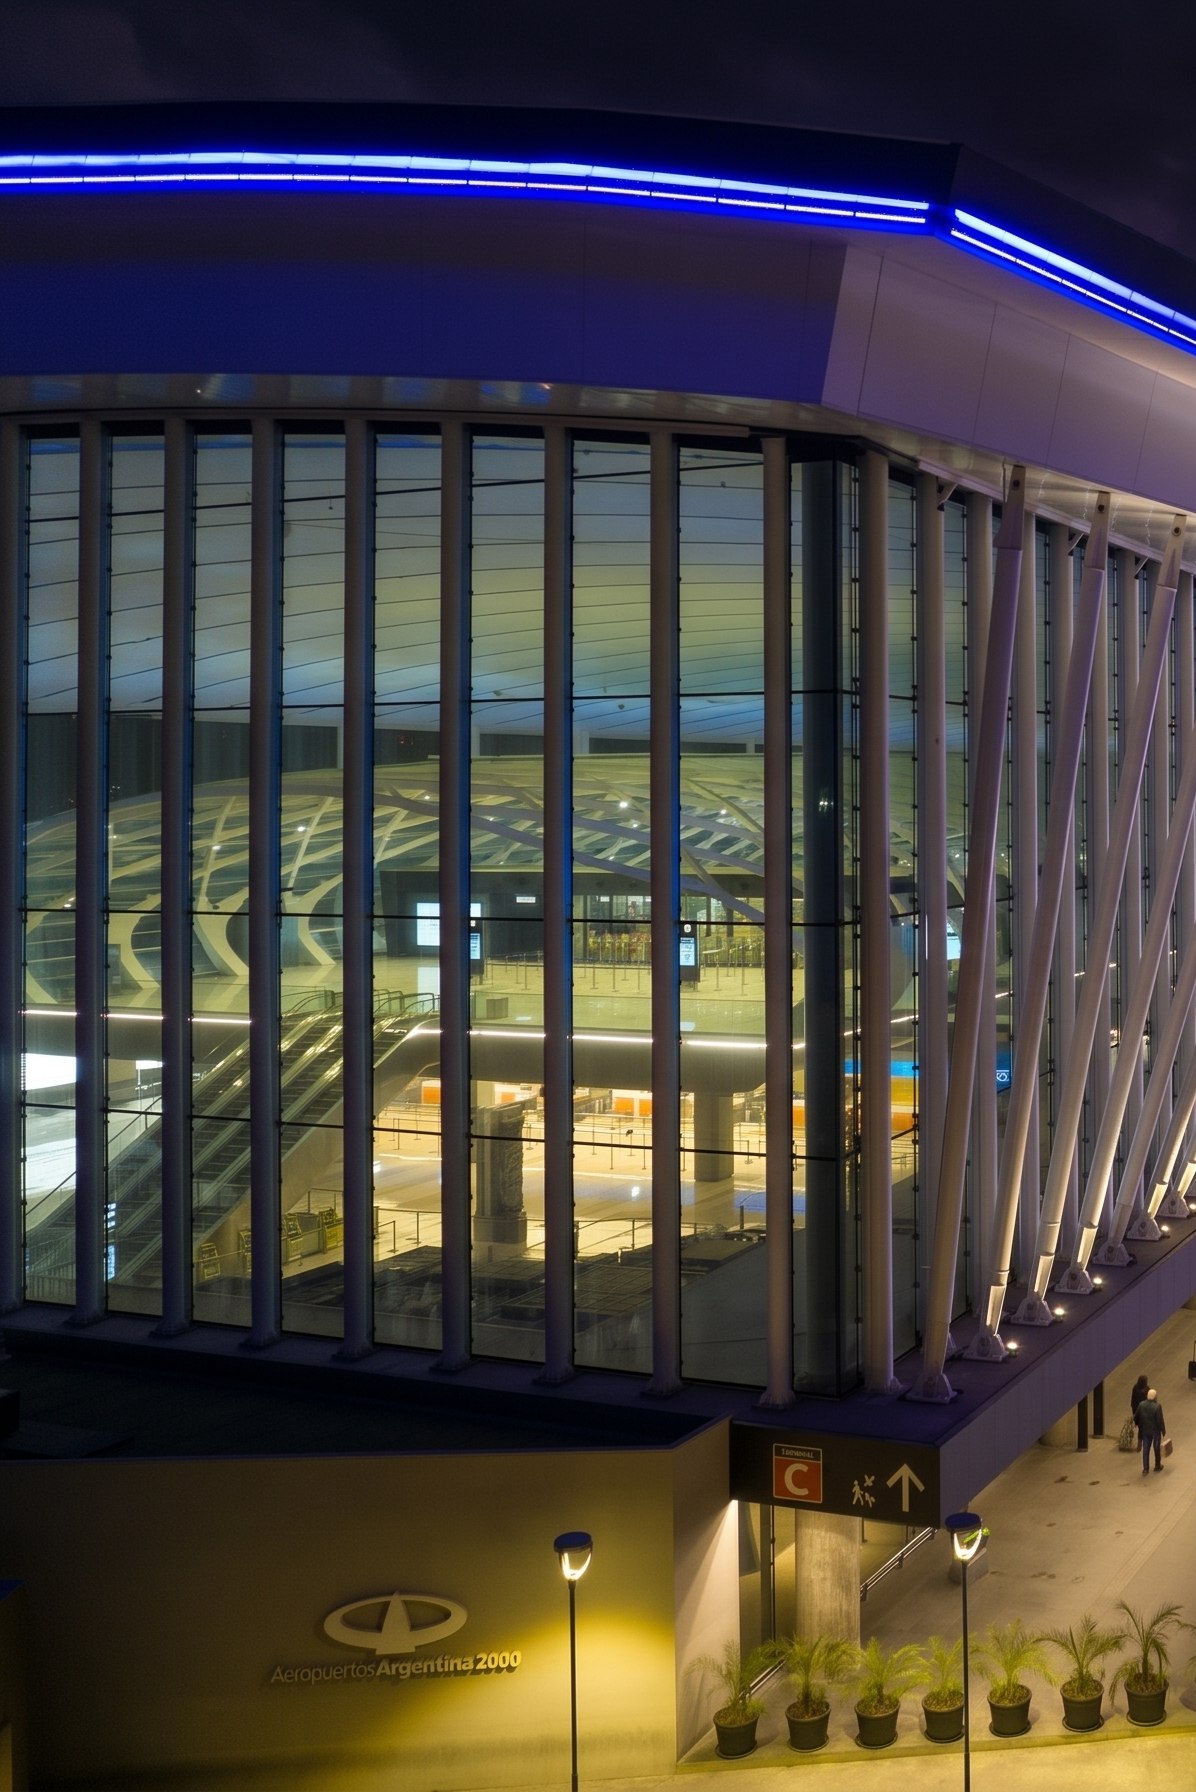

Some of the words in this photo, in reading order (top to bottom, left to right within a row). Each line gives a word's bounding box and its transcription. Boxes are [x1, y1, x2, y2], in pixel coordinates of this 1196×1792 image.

[784, 1462, 809, 1496] C
[271, 1662, 375, 1684] Aeropuertos
[376, 1654, 474, 1679] Argentina
[476, 1651, 522, 1670] 2000
